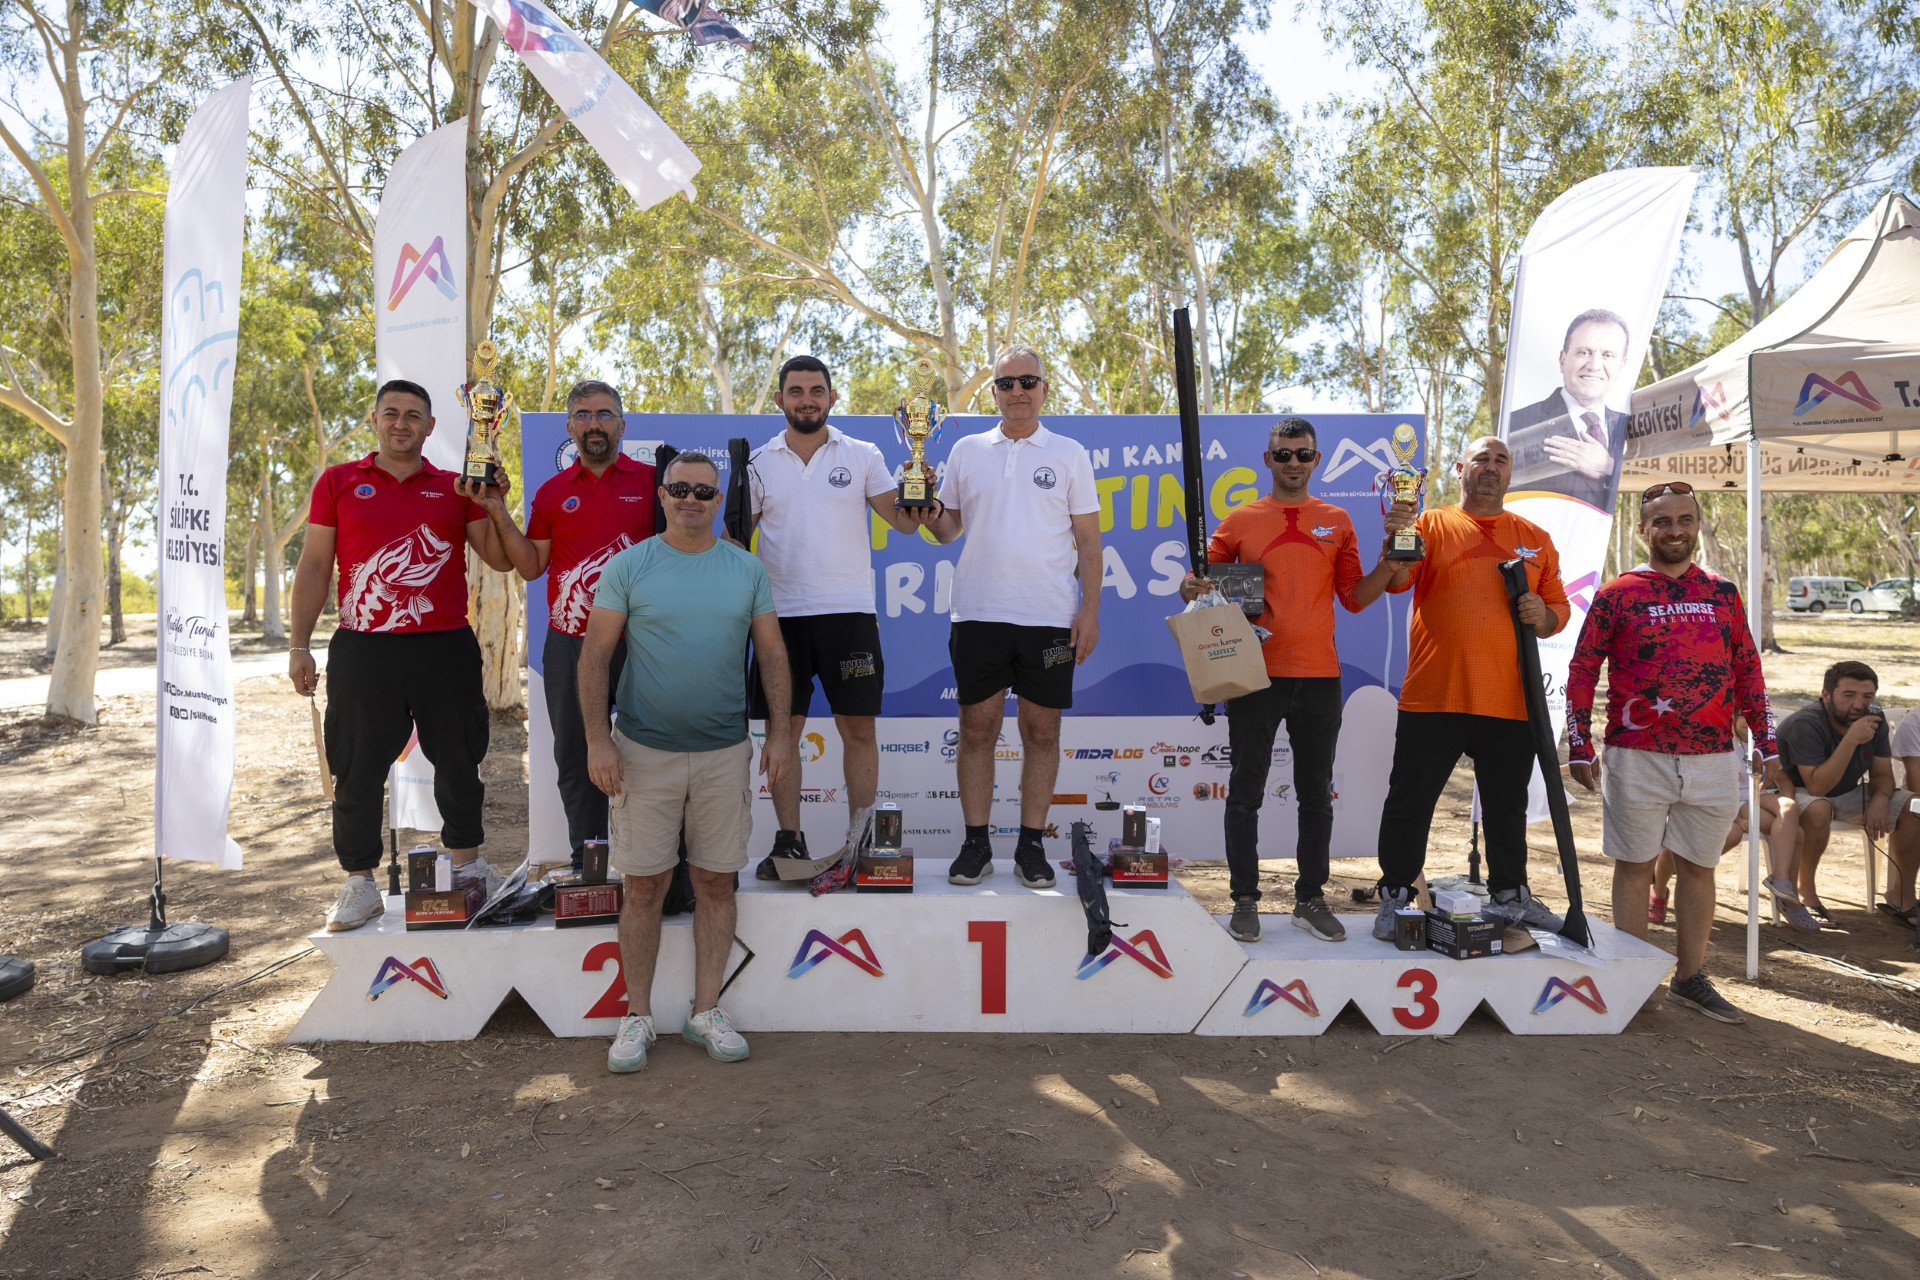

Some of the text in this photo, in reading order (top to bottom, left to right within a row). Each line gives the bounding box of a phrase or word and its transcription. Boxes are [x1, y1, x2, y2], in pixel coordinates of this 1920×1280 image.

[1894, 381, 1920, 408] T.
[179, 473, 199, 497] T.C.
[1648, 602, 1716, 617] SEAHORSE
[1650, 615, 1718, 626] PREMIUM
[1075, 748, 1144, 760] MDRLOG
[1176, 745, 1200, 754] hope
[582, 941, 629, 1018] 2
[968, 921, 1006, 1014] 1
[1392, 968, 1440, 1029] 3
